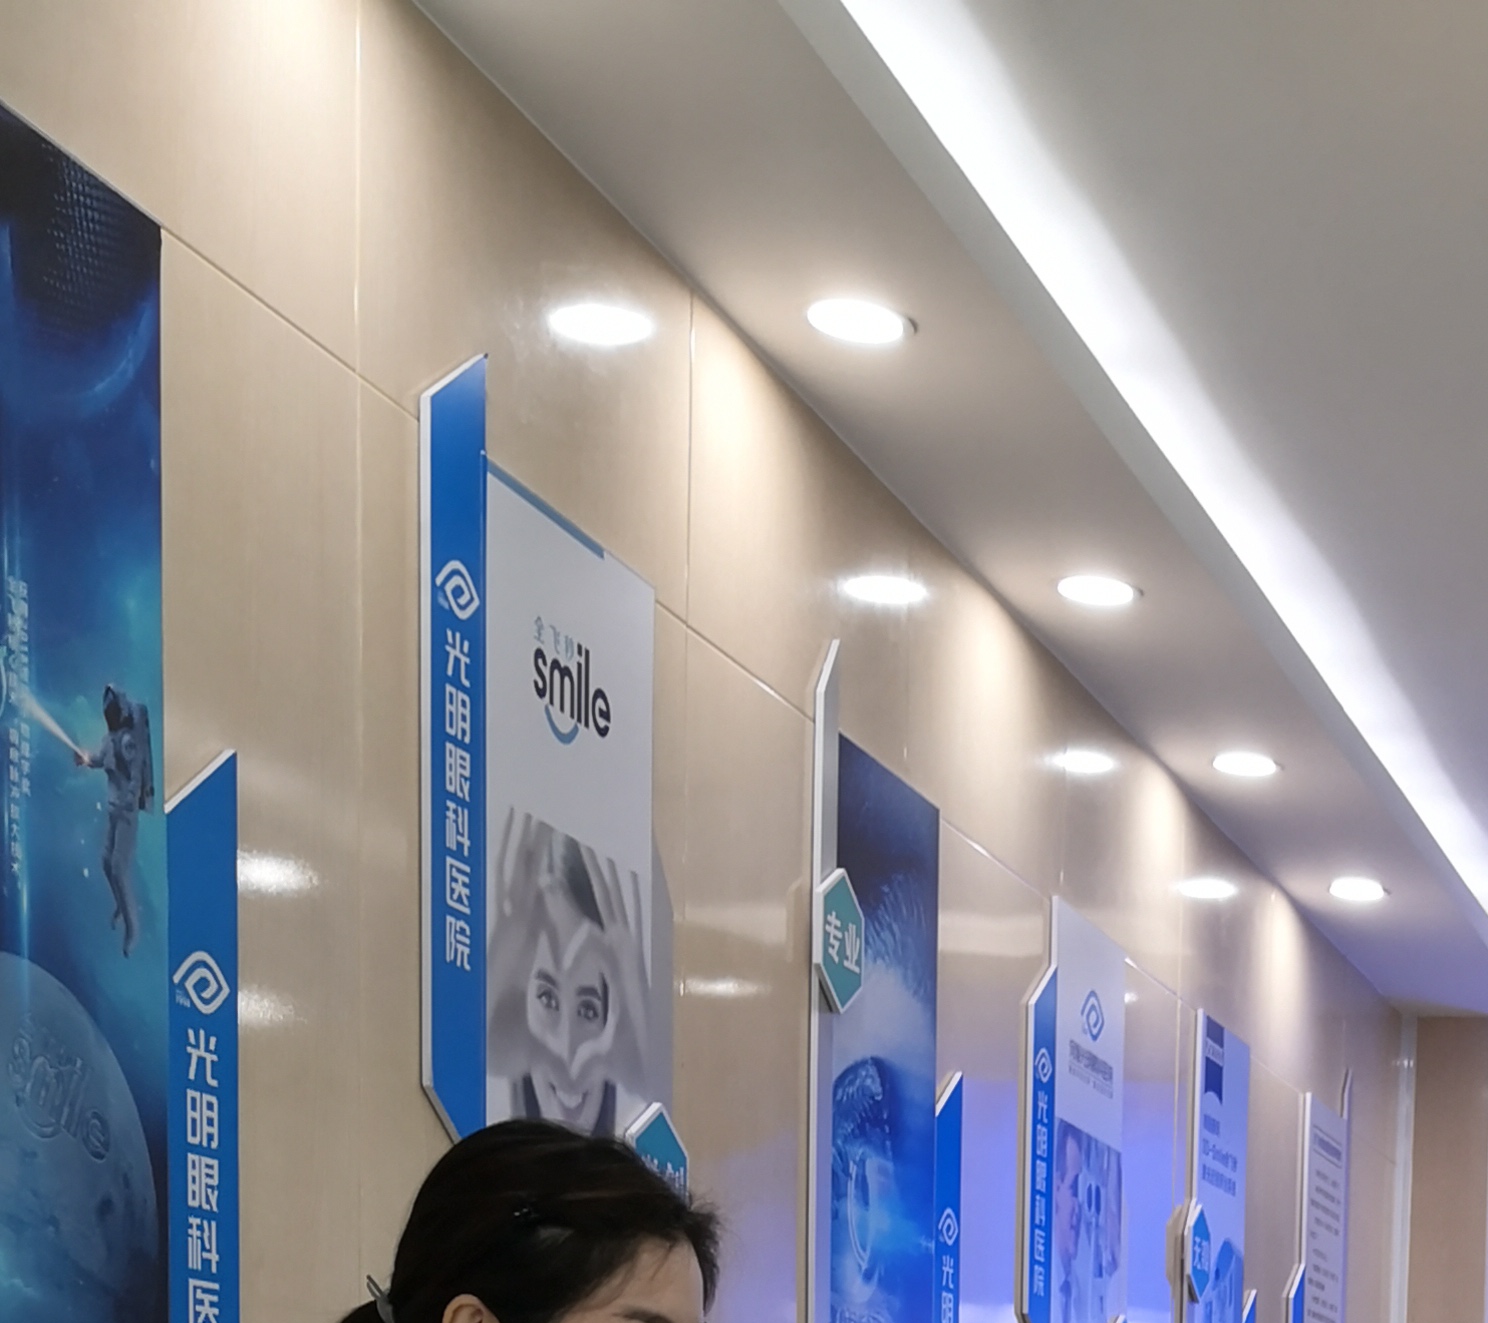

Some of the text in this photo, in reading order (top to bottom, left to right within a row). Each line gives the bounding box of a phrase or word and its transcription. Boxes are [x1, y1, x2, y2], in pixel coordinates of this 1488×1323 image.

[533, 642, 612, 739] smile
[444, 627, 471, 972] 光明眼科医院
[825, 910, 861, 975] 专业
[1032, 1090, 1049, 1299] 光明眼科医院
